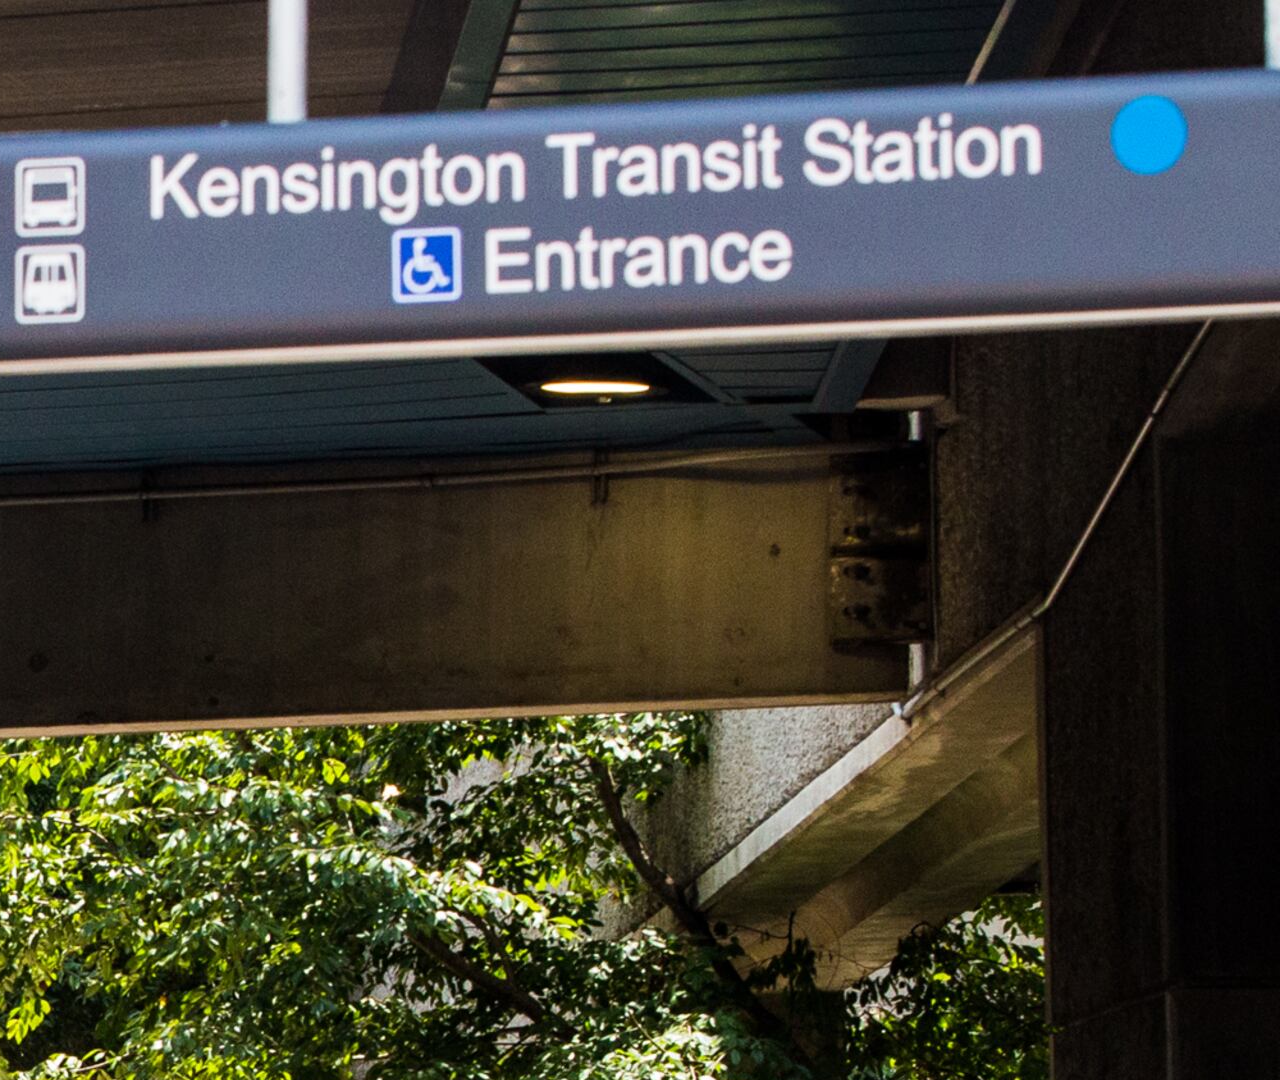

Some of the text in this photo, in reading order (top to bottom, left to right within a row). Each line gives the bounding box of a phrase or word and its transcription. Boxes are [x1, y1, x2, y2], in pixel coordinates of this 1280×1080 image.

[149, 112, 1042, 225] Kensington Transit Station
[484, 226, 793, 294] Entrance
